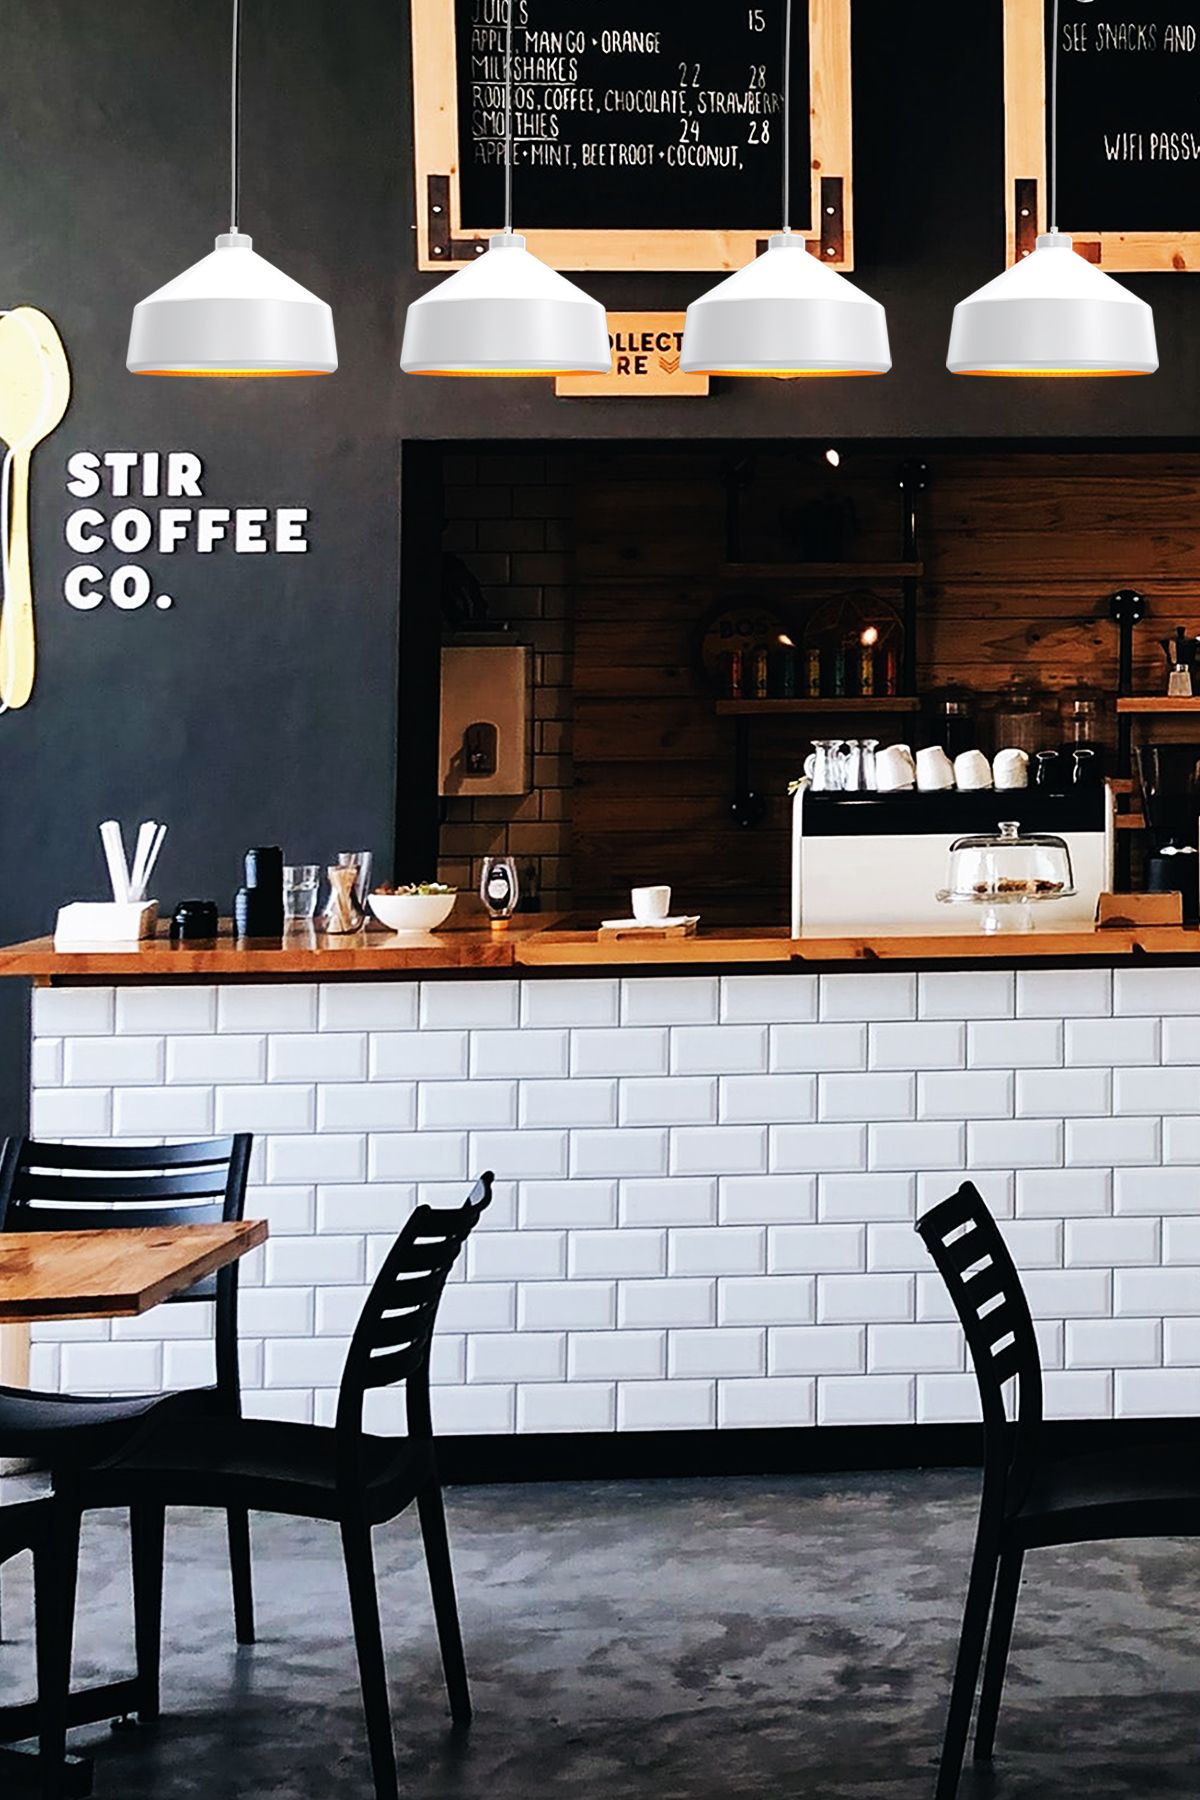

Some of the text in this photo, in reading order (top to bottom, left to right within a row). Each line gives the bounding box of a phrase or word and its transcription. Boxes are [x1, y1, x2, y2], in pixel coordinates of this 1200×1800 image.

[471, 0, 528, 24] JUICS
[748, 9, 765, 32] 15
[601, 31, 661, 54] ORANGE
[1062, 23, 1197, 53] SEE SNACKS AND
[471, 56, 767, 90] MILKSHAKES 22 28
[604, 90, 693, 116] CHOCOLATE,
[471, 111, 770, 144] SMOTHIES 24 28
[582, 144, 655, 167] BEETROOT
[667, 145, 744, 171] COCONUT,
[1104, 133, 1143, 161] WIFI
[66, 452, 203, 497] STIR
[65, 508, 309, 554] COFFEE
[63, 563, 173, 610] CO.
